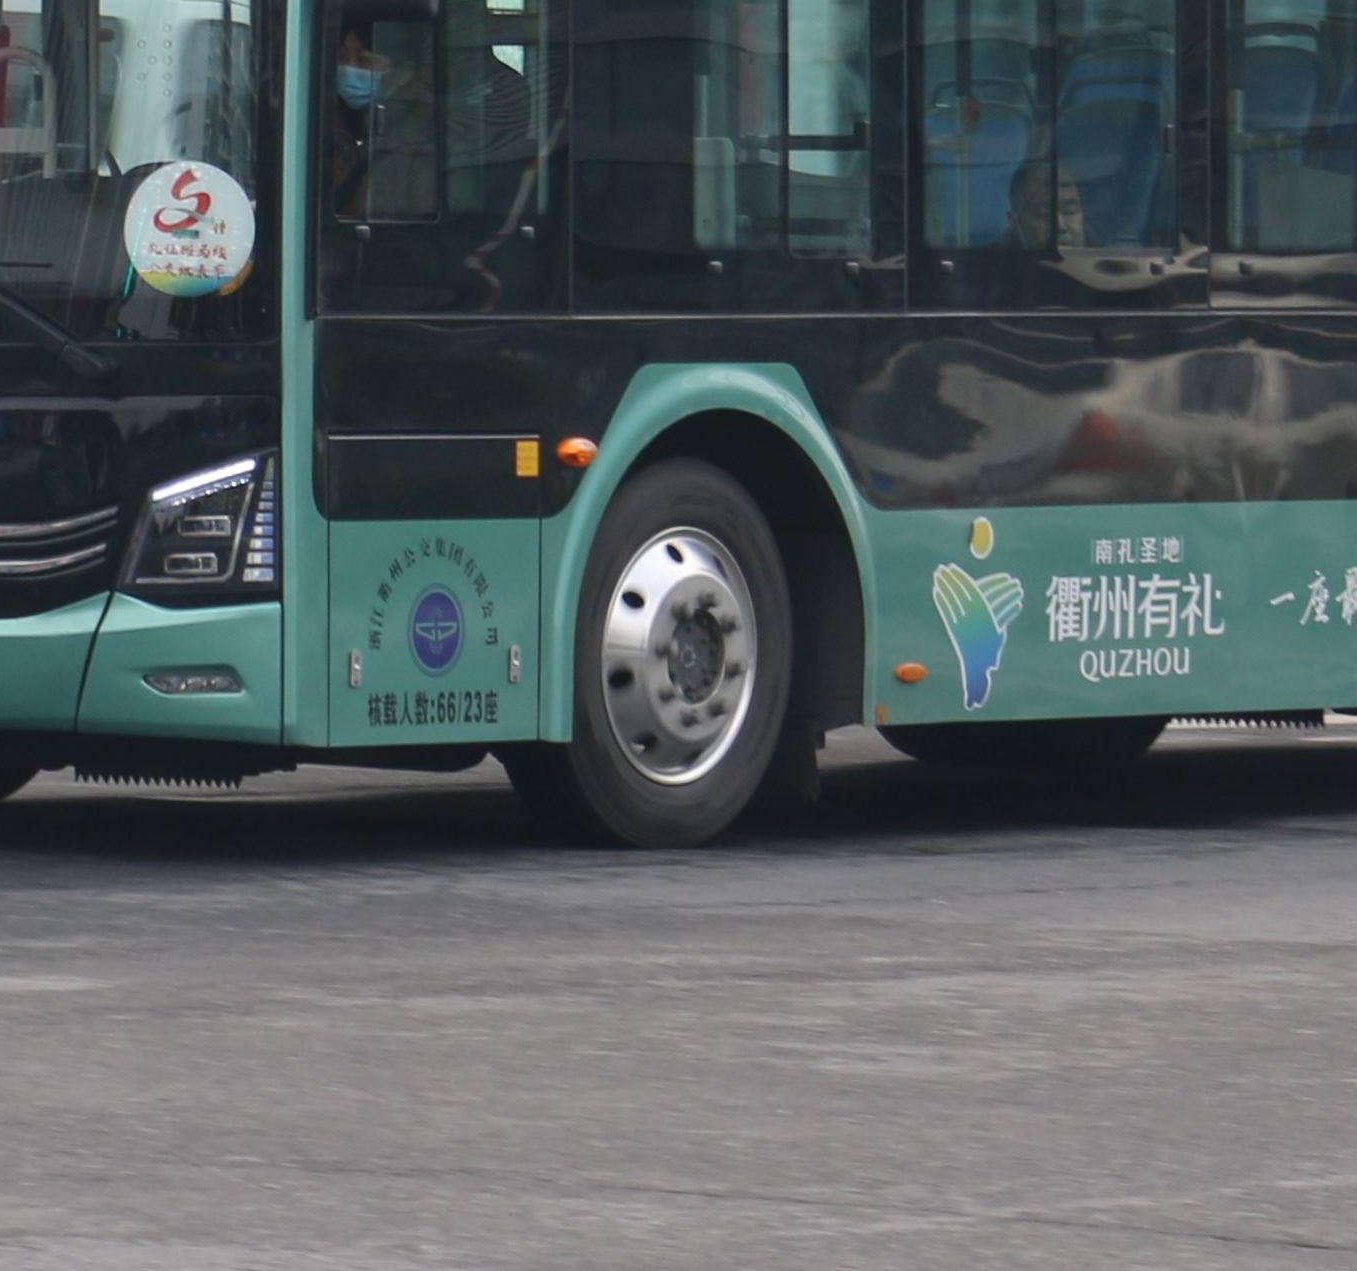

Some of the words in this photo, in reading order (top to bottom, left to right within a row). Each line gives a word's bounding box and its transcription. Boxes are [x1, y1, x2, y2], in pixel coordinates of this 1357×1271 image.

[1095, 536, 1182, 565] 南孔圣地
[1045, 572, 1226, 643] 衢州有礼
[1080, 647, 1190, 682] QUZHOU
